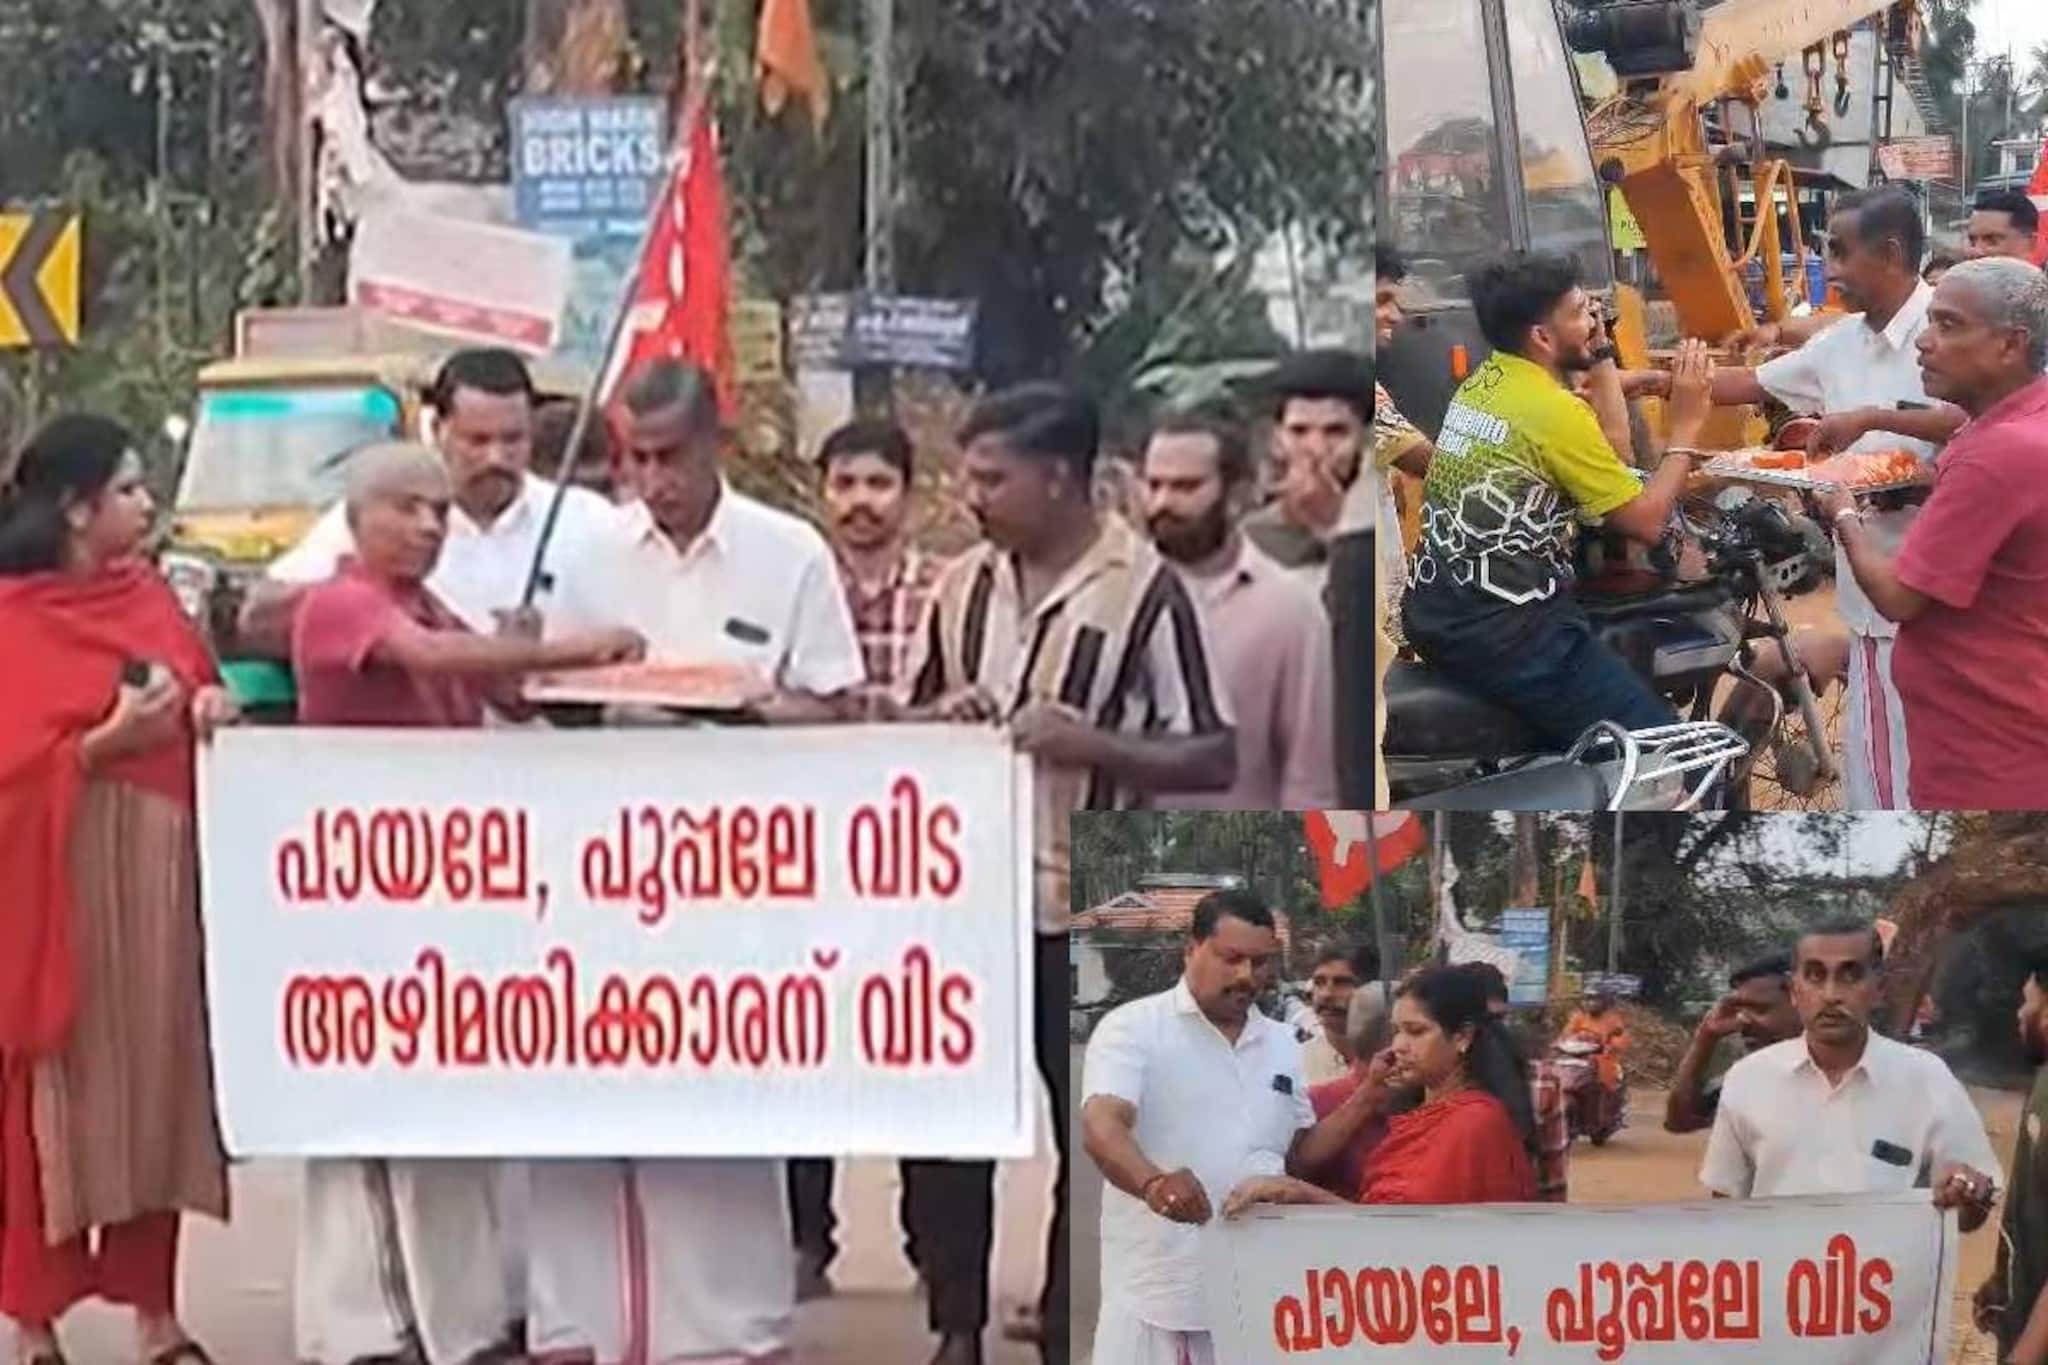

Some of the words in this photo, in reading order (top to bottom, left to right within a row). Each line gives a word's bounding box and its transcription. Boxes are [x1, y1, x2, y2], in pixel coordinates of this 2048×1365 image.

[523, 134, 660, 175] BRICKS
[277, 808, 549, 920] പായലേ,
[582, 806, 817, 924] പൂപ്പലേ
[848, 775, 962, 899] വിട
[282, 948, 838, 1069] അഴിമതിക്കാരന്
[859, 946, 974, 1069] വിട
[1273, 1265, 1522, 1356] പായലേ,
[1545, 1260, 1760, 1362] പൂപ്പലേ
[1786, 1234, 1894, 1338] വിട
